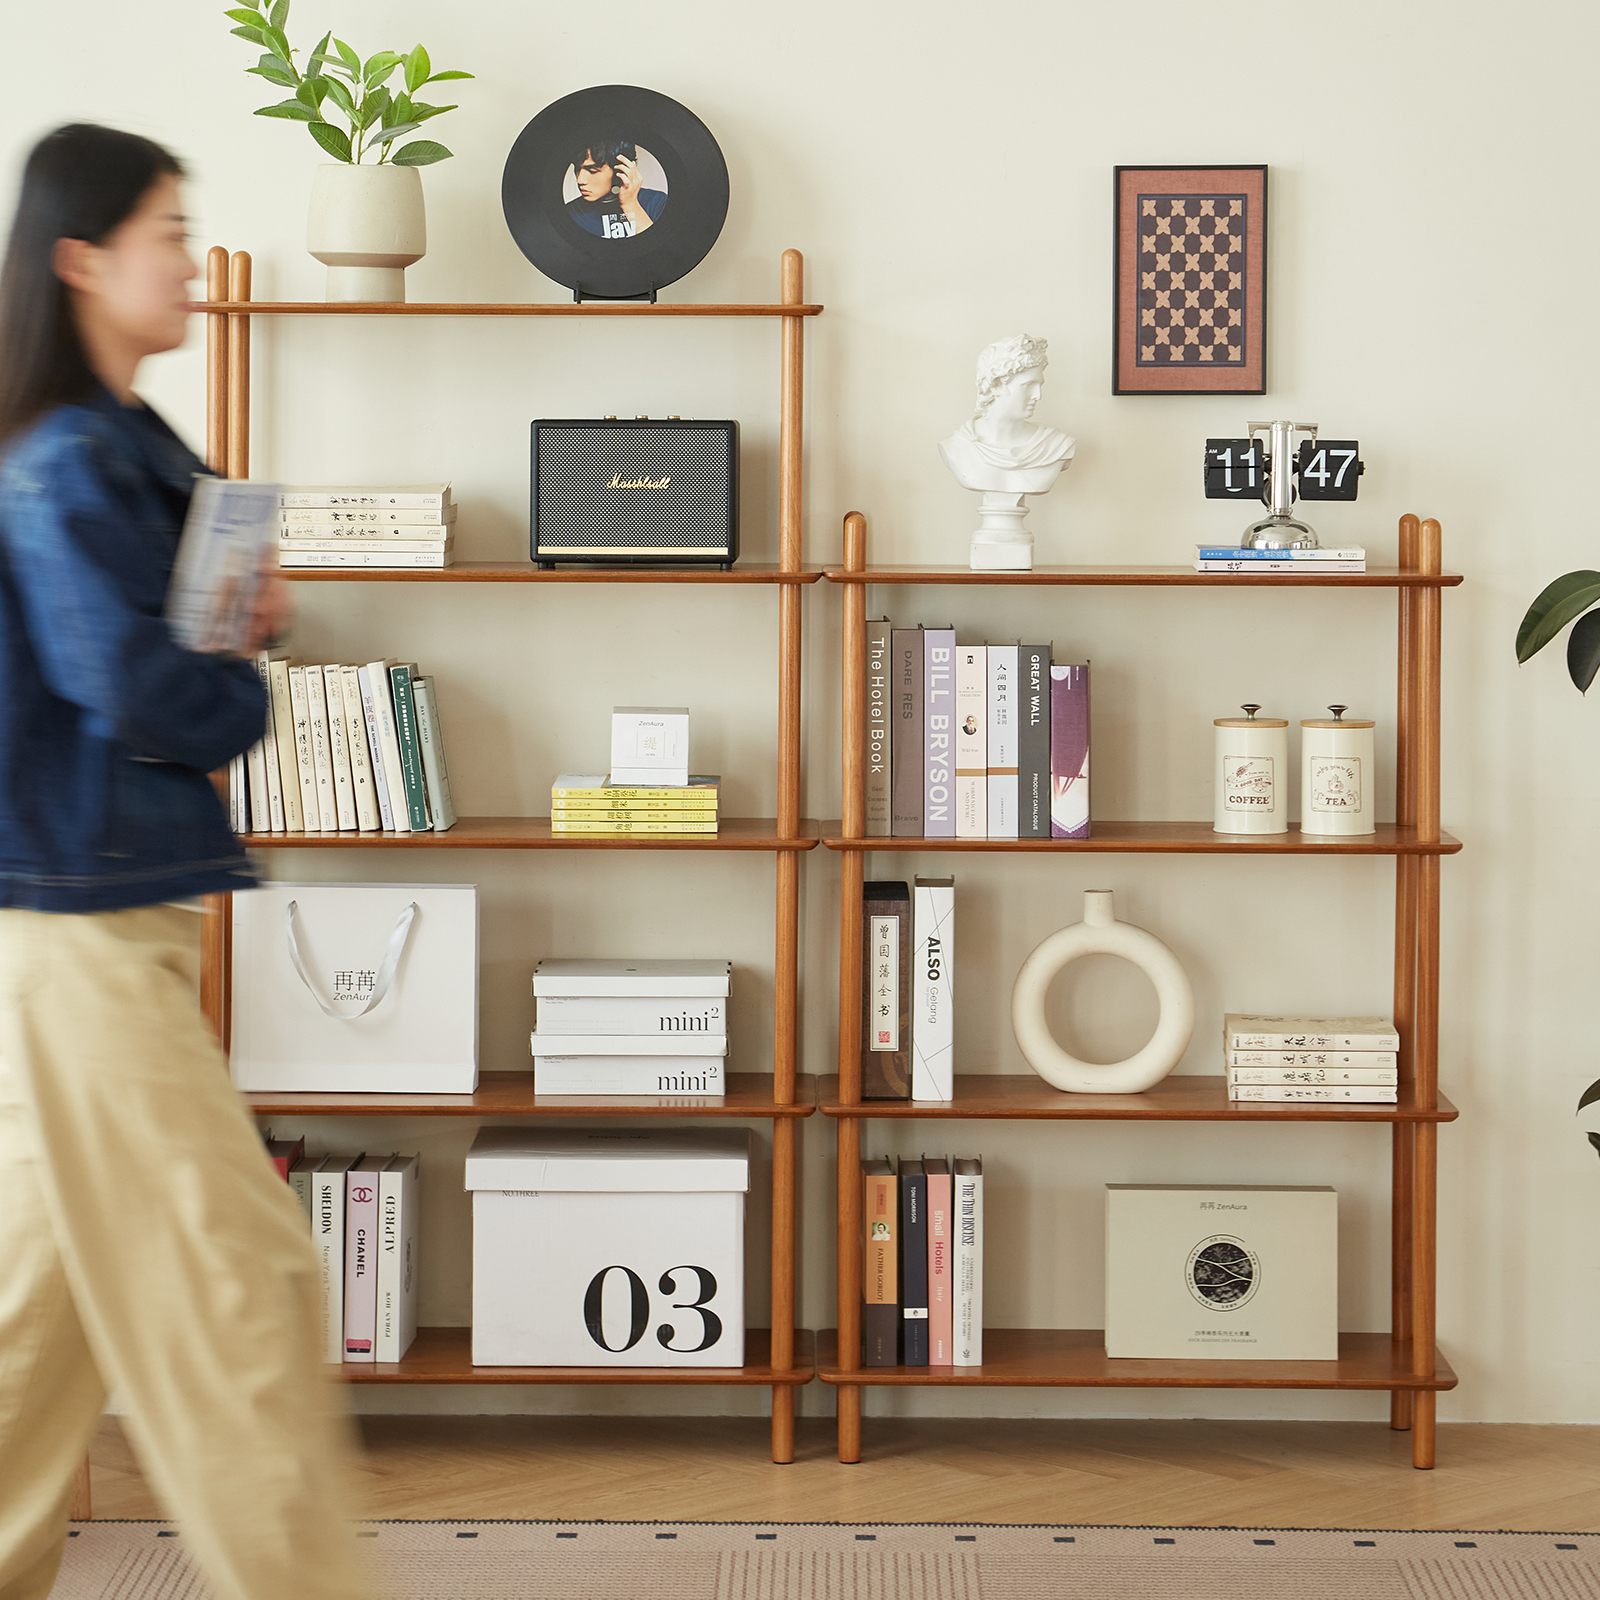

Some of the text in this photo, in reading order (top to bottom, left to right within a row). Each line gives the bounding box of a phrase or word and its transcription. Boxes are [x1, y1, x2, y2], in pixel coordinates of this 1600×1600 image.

[1217, 447, 1256, 488] 11
[1303, 449, 1357, 488] 47
[871, 637, 885, 773] The Hotel Book
[903, 650, 913, 720] DARE RES
[1030, 654, 1040, 727] GREAT WALL
[929, 647, 950, 822] BILL BRYSON
[894, 814, 919, 822] Bravo
[1229, 794, 1270, 805] COFFEE
[1325, 797, 1347, 806] TEA
[877, 923, 892, 1018] 曾国藩全书
[927, 936, 941, 1024] ALSO Gelang
[333, 992, 373, 1001] ZenAur
[320, 1184, 332, 1235] SHELDON
[385, 1195, 396, 1254] ALPRED
[934, 1210, 944, 1236] small
[356, 1228, 365, 1279] CHANEL
[935, 1241, 944, 1275] Hotels
[583, 1264, 723, 1353] 03
